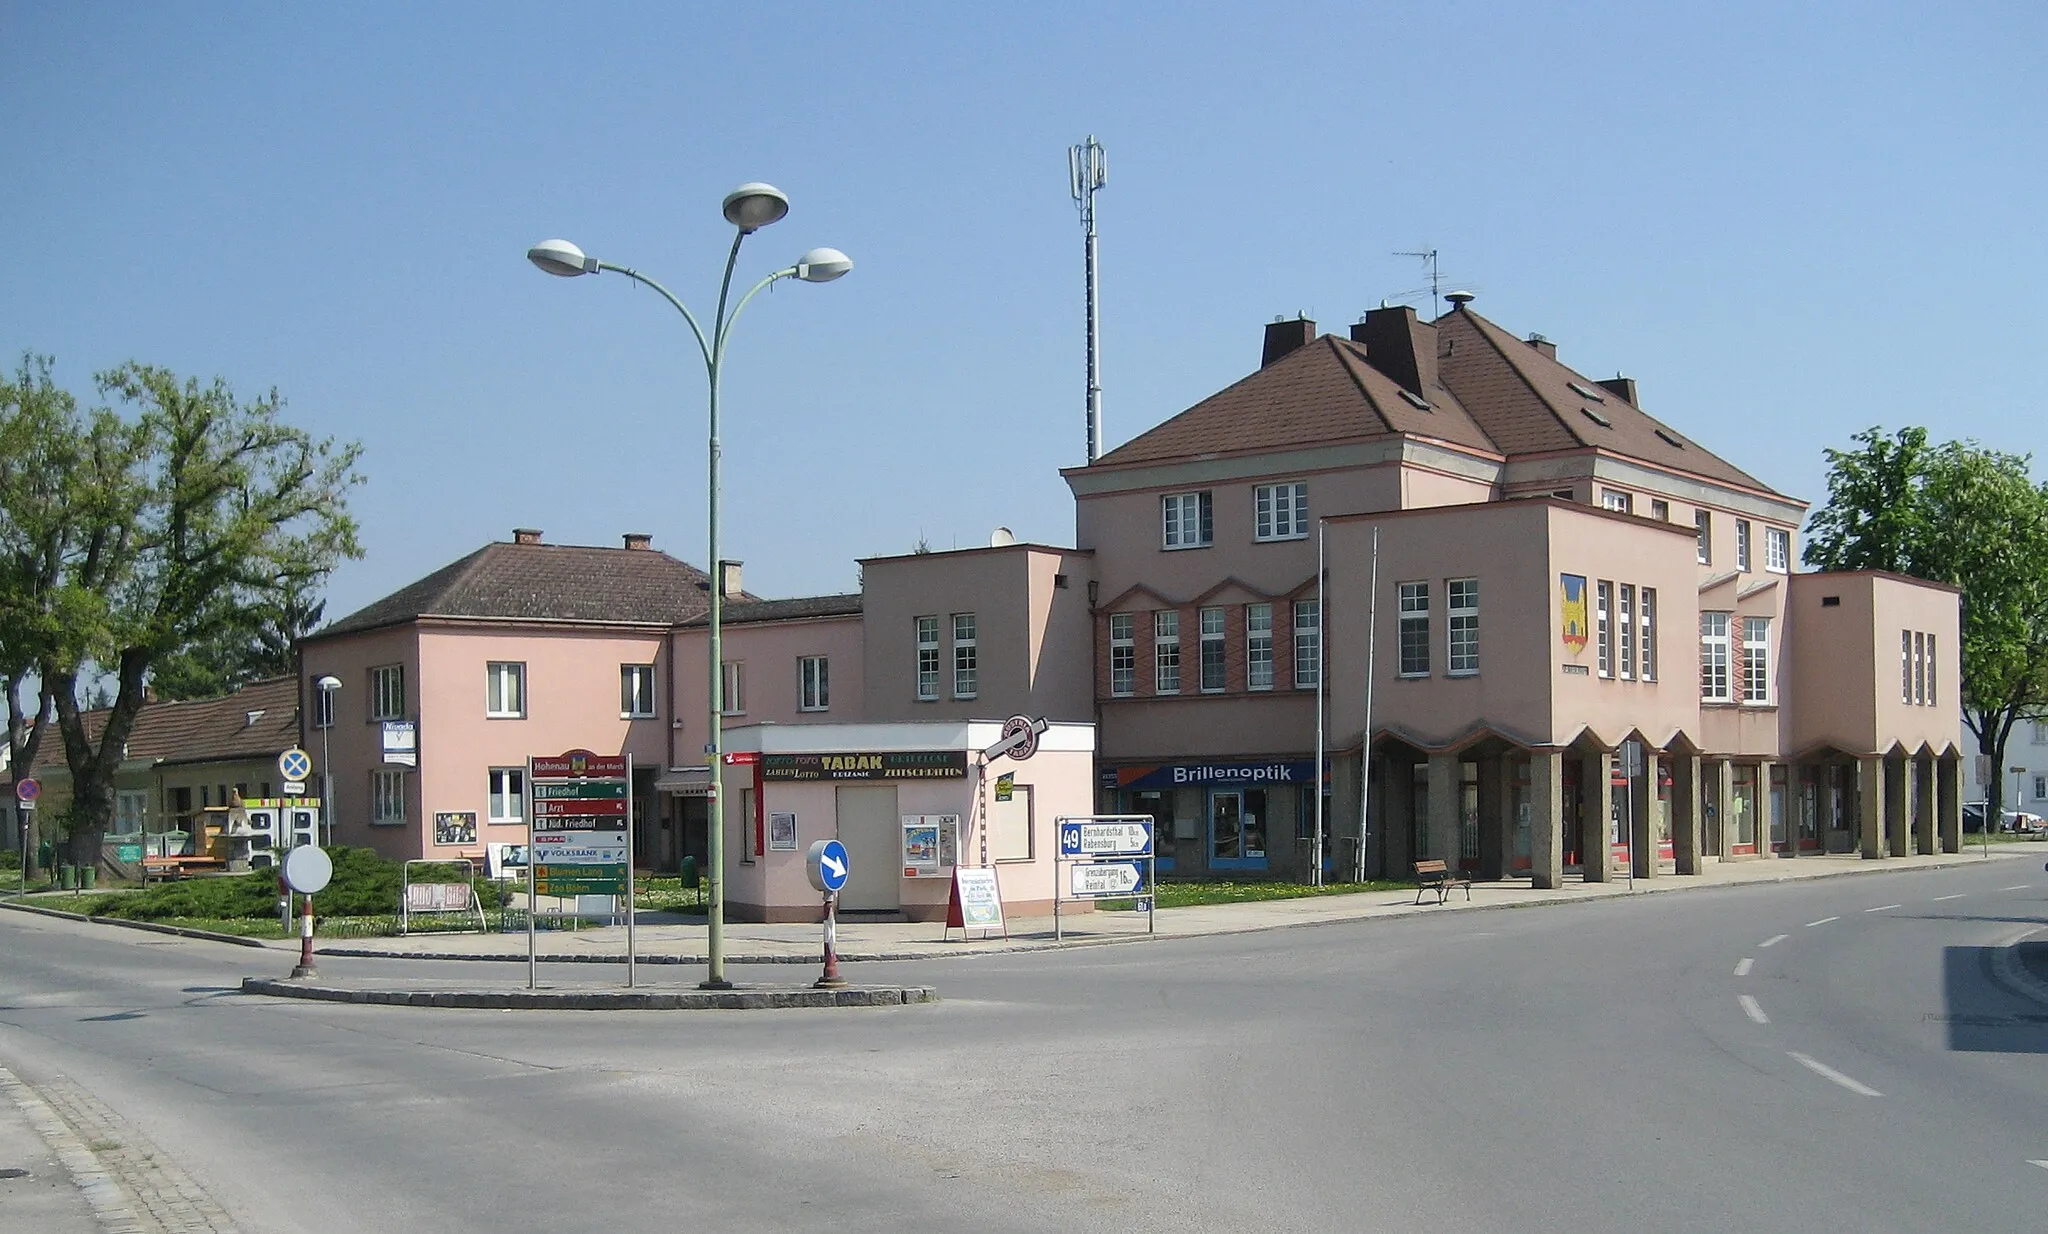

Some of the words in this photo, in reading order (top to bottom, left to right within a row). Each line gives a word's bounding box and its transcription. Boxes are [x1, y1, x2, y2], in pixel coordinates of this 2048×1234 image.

[1004, 720, 1031, 737] AUSTRIA
[1009, 739, 1031, 757] TABAK
[535, 762, 570, 771] Hohenau
[821, 755, 882, 770] TABAK
[1173, 764, 1292, 782] Brillenoptik
[548, 787, 579, 796] Friedhof
[548, 804, 564, 812] Arzt
[565, 818, 596, 828] Friedhof
[1083, 826, 1124, 837] Bernhardsthal
[1063, 830, 1079, 849] 49
[1083, 839, 1117, 850] Rabensburg
